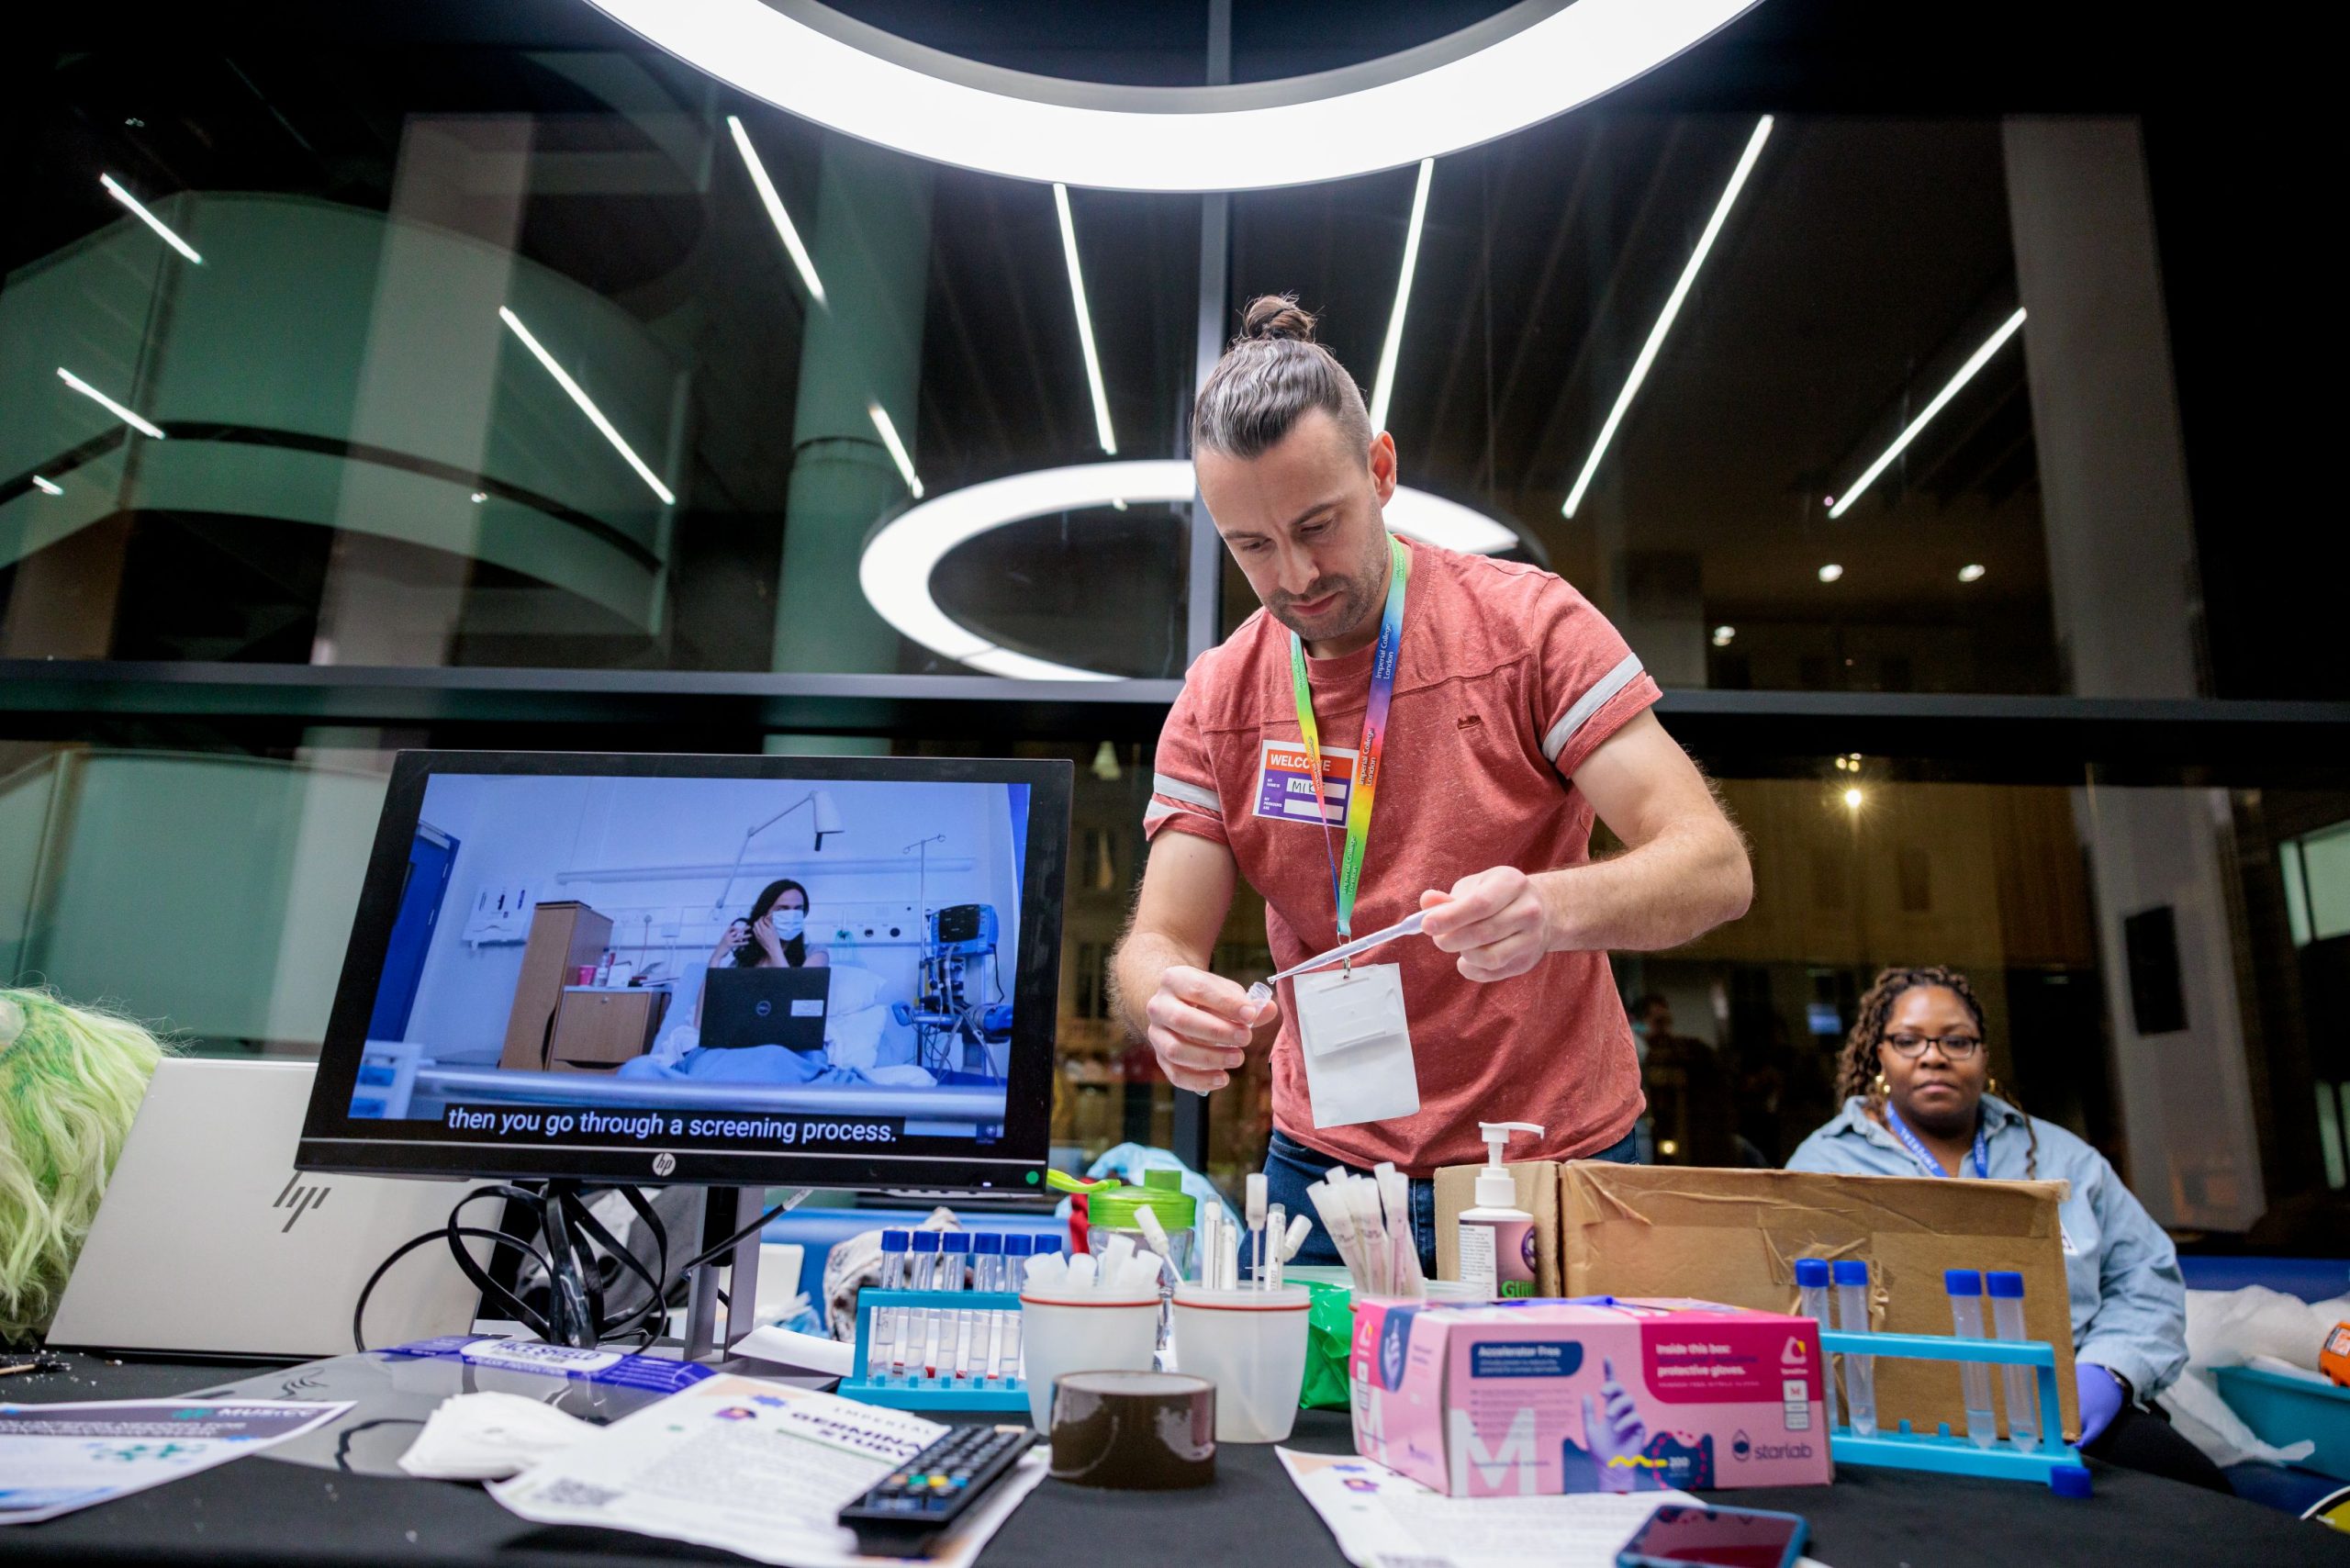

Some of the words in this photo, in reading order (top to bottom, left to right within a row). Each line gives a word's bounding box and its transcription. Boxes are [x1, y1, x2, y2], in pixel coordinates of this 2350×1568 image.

[1375, 646, 1386, 679] Imperial
[1381, 623, 1393, 648] College
[1383, 651, 1394, 679] London
[1363, 728, 1374, 755] College
[1270, 754, 1332, 772] WELCOE
[1359, 755, 1369, 786] Imperial
[1365, 756, 1377, 787] London
[448, 1108, 496, 1131] then
[499, 1114, 541, 1135] you
[545, 1114, 575, 1137] go
[579, 1112, 663, 1139] through
[669, 1120, 683, 1135] a
[688, 1117, 796, 1144] screening
[801, 1121, 898, 1144] process.
[653, 1152, 677, 1177] hp
[1754, 1443, 1813, 1460] starlab
